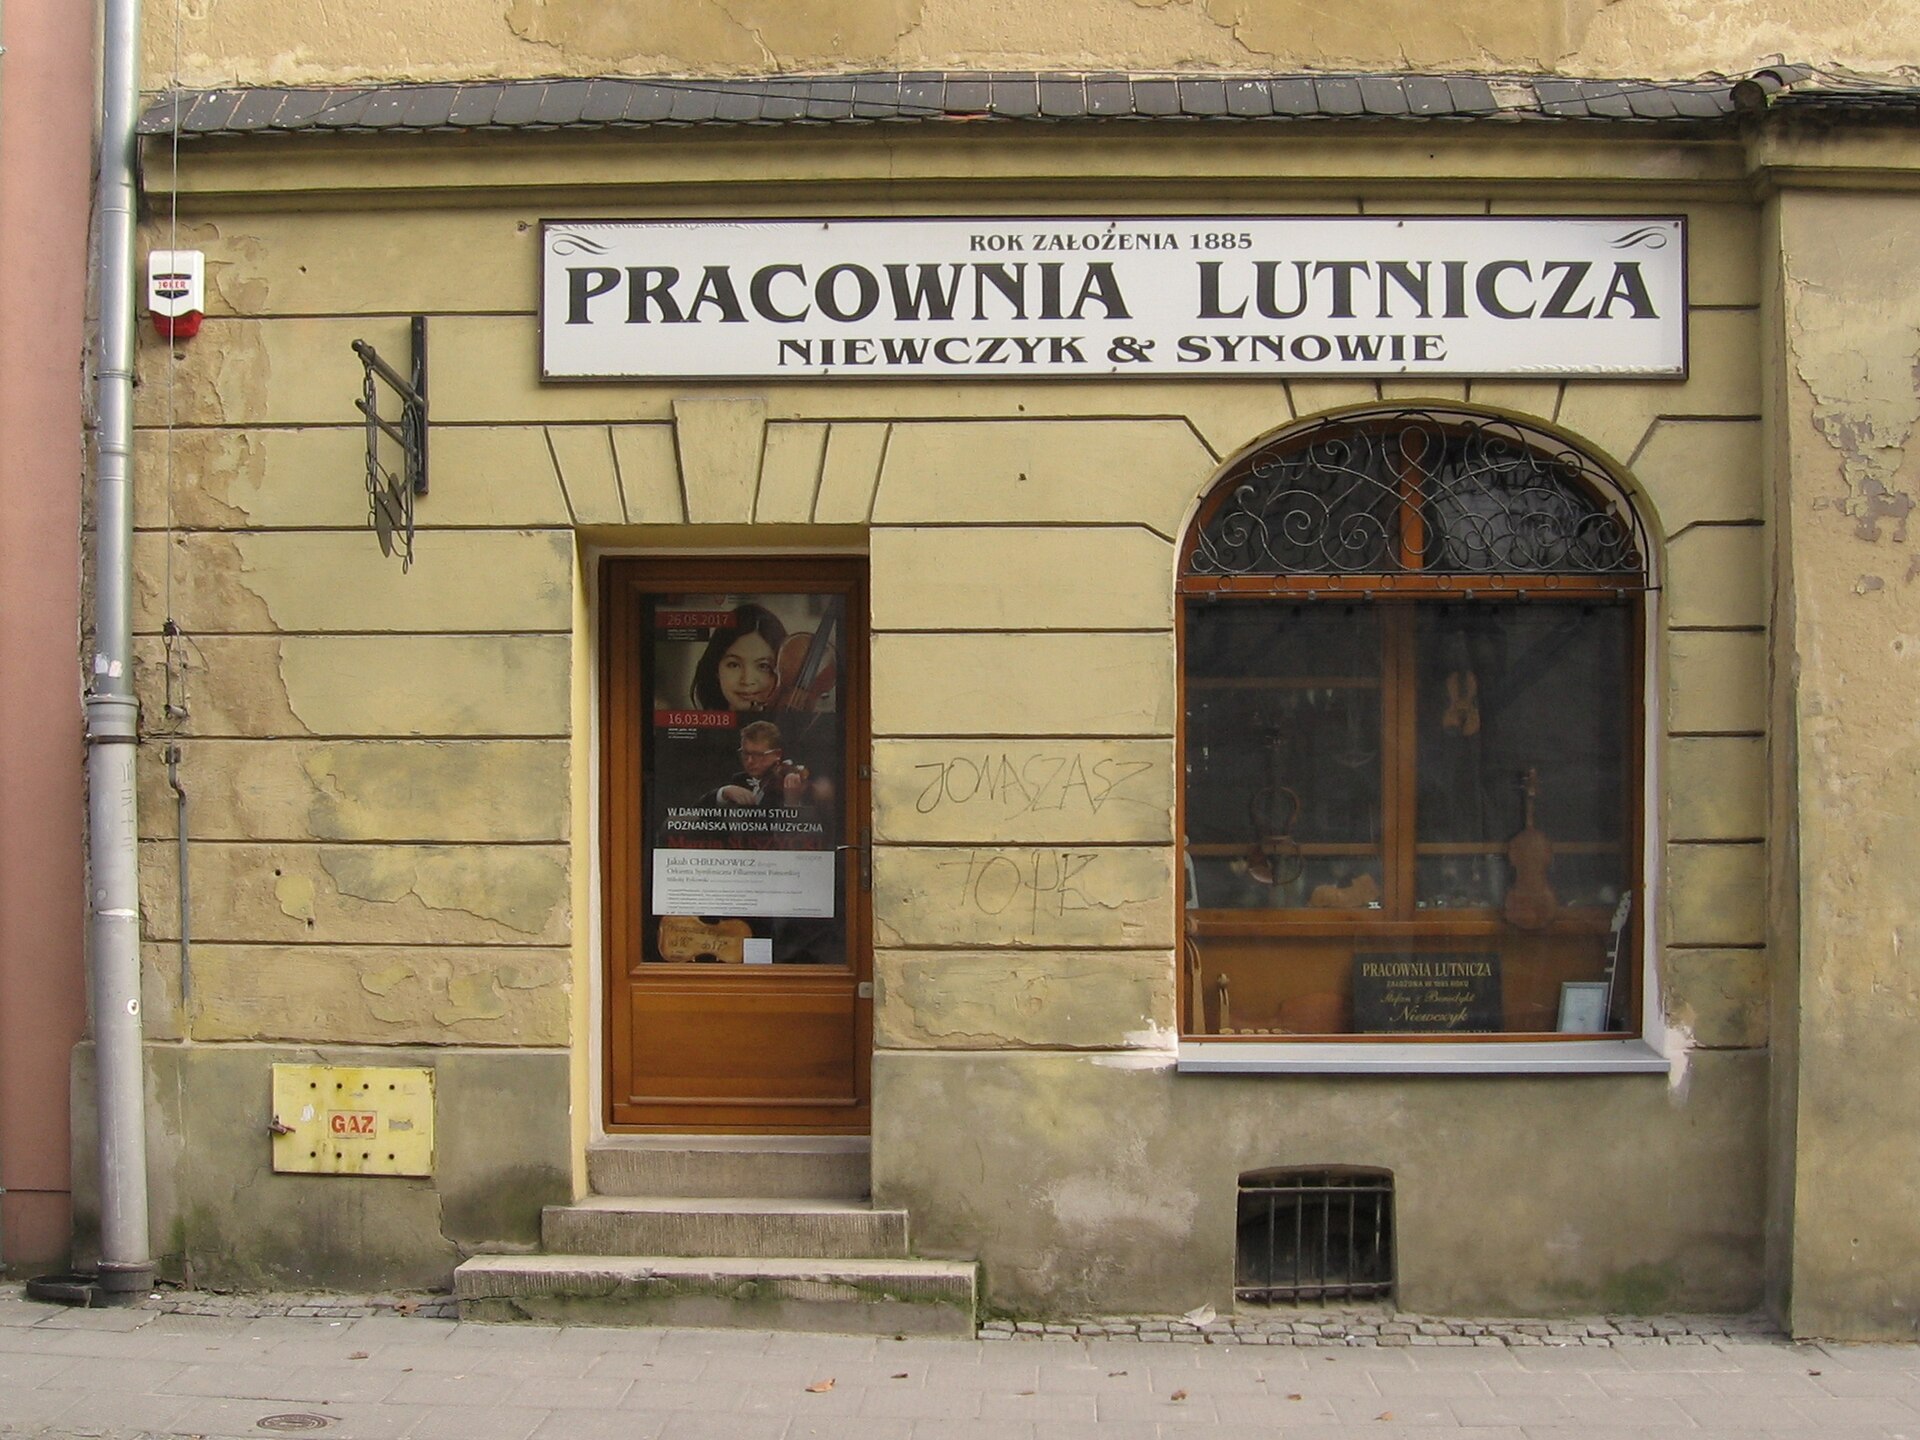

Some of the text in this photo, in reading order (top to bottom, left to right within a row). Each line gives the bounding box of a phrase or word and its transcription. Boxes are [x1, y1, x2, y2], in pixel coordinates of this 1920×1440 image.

[970, 228, 1253, 250] ROK ZAŁOŻENIA 1885
[158, 281, 187, 289] JOKER
[565, 260, 1660, 324] PRACOWNIA LUTNICZA
[777, 334, 1447, 366] NIEWCZYK & SYNOWIE
[667, 614, 729, 627] 26.05.2017
[668, 713, 730, 726] 16.03.2018
[667, 808, 798, 818] W DAWNYM I NOWYM STYLU
[728, 821, 768, 831] WIOSNA
[769, 822, 823, 833] MUZYCZNA
[666, 857, 689, 868] Jakub
[689, 857, 756, 867] CHRENOWICZ
[1363, 963, 1492, 977] PRACOWNIA LUTNICZA
[1389, 1004, 1469, 1028] Niewczyk
[331, 1115, 374, 1133] GAZ
